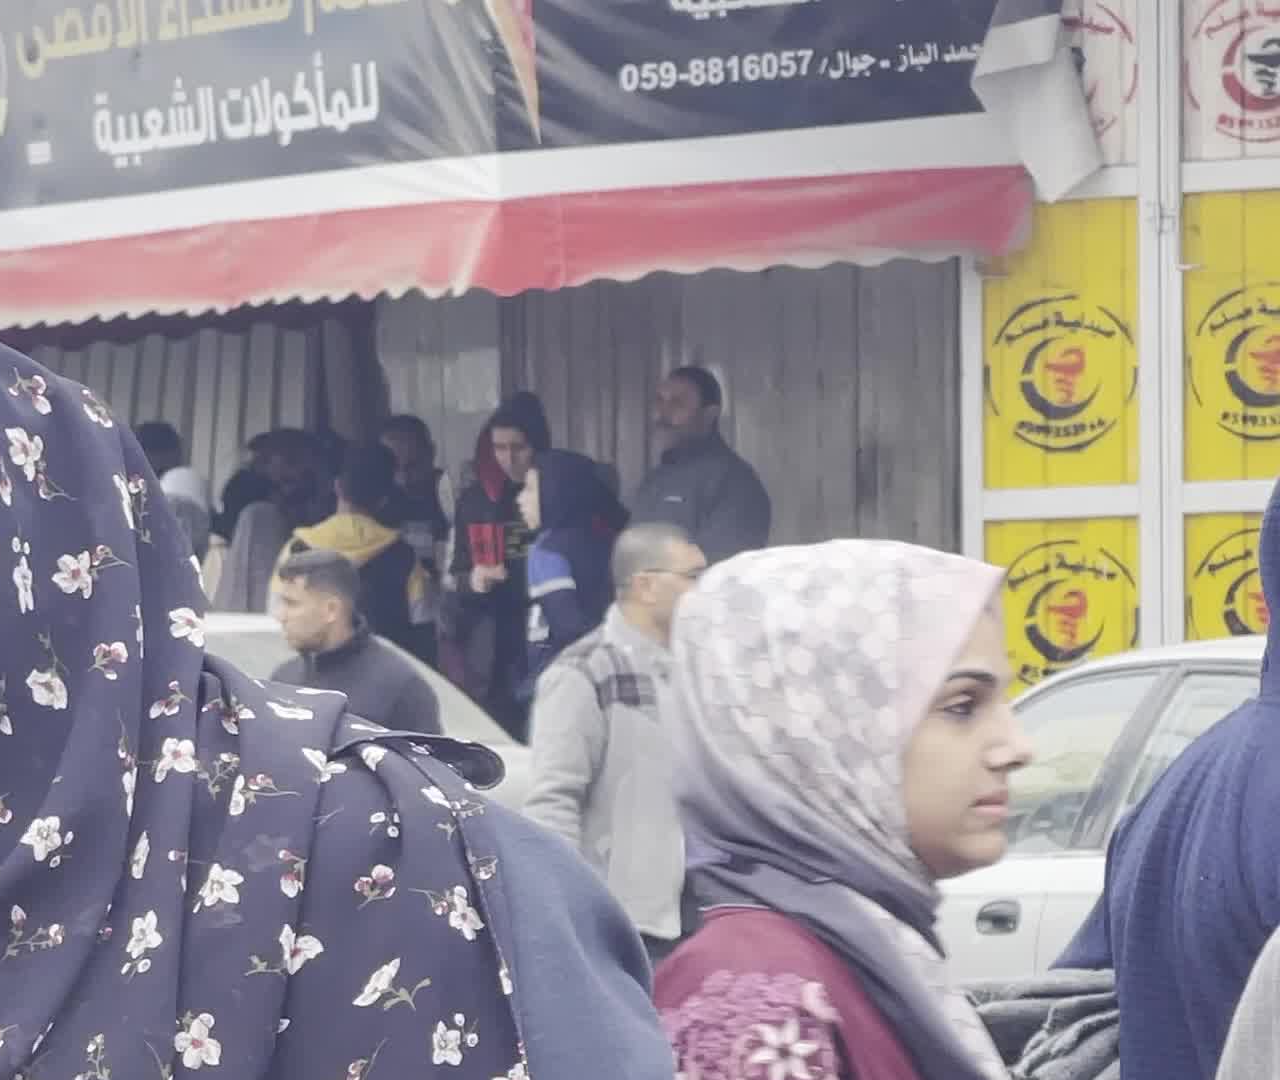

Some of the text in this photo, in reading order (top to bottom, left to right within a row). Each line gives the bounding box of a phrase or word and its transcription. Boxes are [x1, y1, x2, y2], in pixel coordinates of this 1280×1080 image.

[220, 51, 380, 147] للمأكولات
[619, 49, 814, 92] 059-8816057
[92, 76, 218, 168] الشعبية
